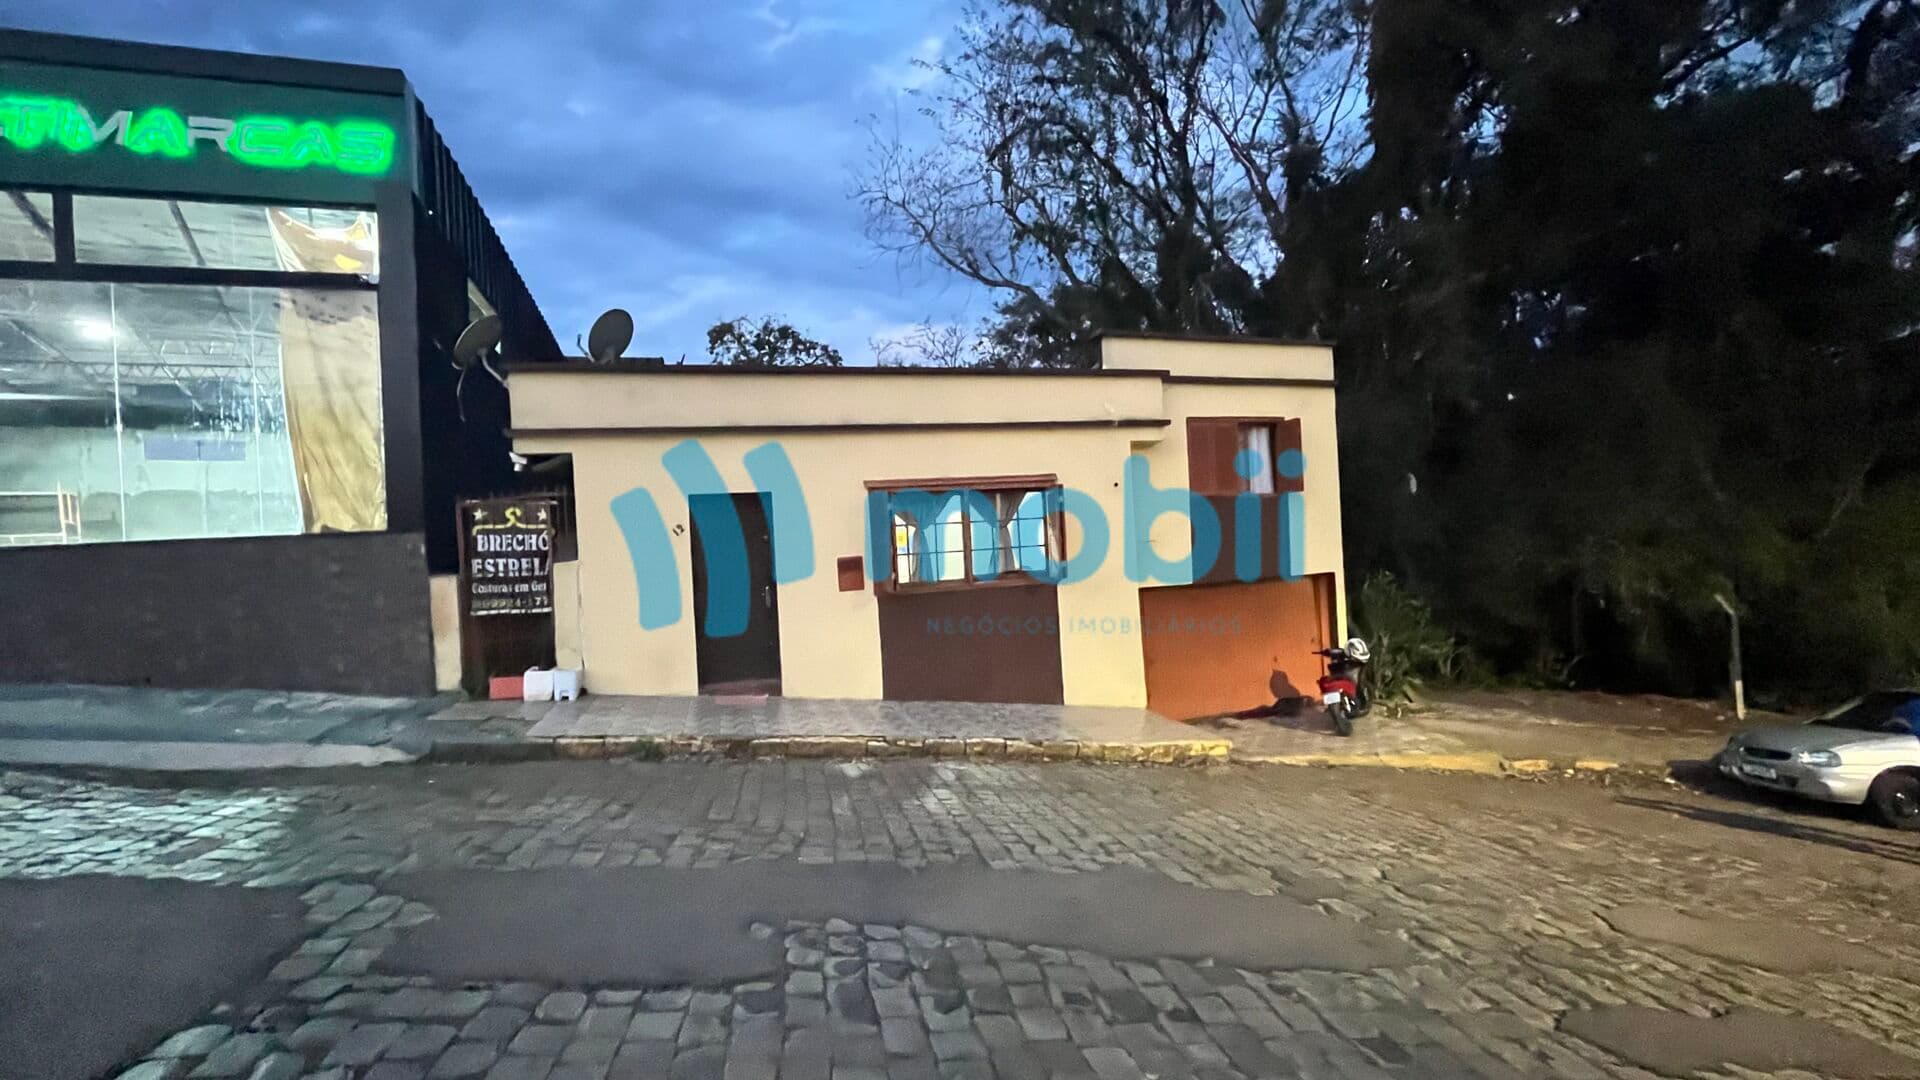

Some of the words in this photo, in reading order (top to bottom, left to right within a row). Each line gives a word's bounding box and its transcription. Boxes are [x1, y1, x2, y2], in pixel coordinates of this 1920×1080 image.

[0, 100, 388, 165] TIMARCAS
[477, 530, 549, 551] BRECHÓ
[514, 583, 529, 593] em
